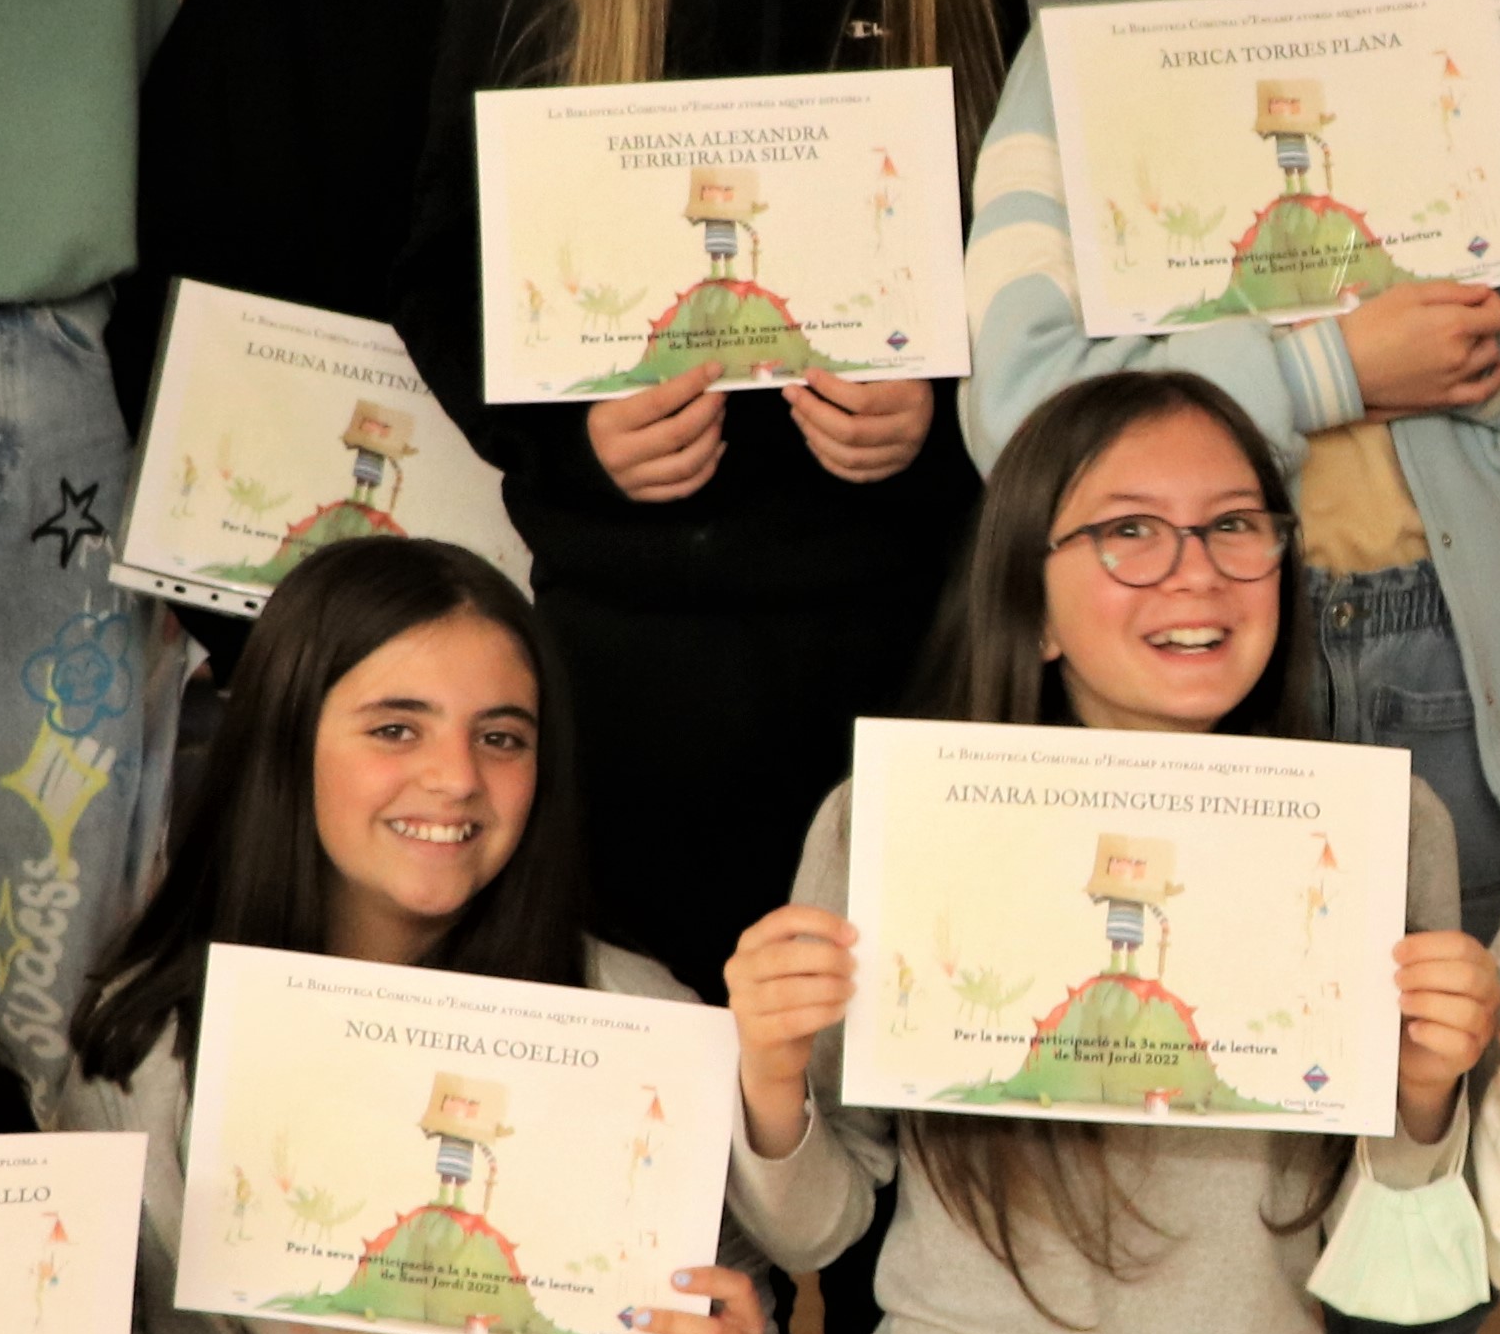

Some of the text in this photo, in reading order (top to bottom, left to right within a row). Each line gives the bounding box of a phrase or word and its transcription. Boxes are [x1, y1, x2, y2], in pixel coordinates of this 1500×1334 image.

[1241, 40, 1326, 62] TORRES
[1332, 31, 1402, 54] PLANA
[608, 125, 829, 151] FABIANA ALEXANDRA
[621, 145, 819, 169] FERREIRA DA SILVA
[247, 341, 326, 373] LORENA
[945, 784, 1320, 820] AINARA DOMINGUES PINHEIRO
[345, 1020, 599, 1069] NOA VIEIRA COELHO
